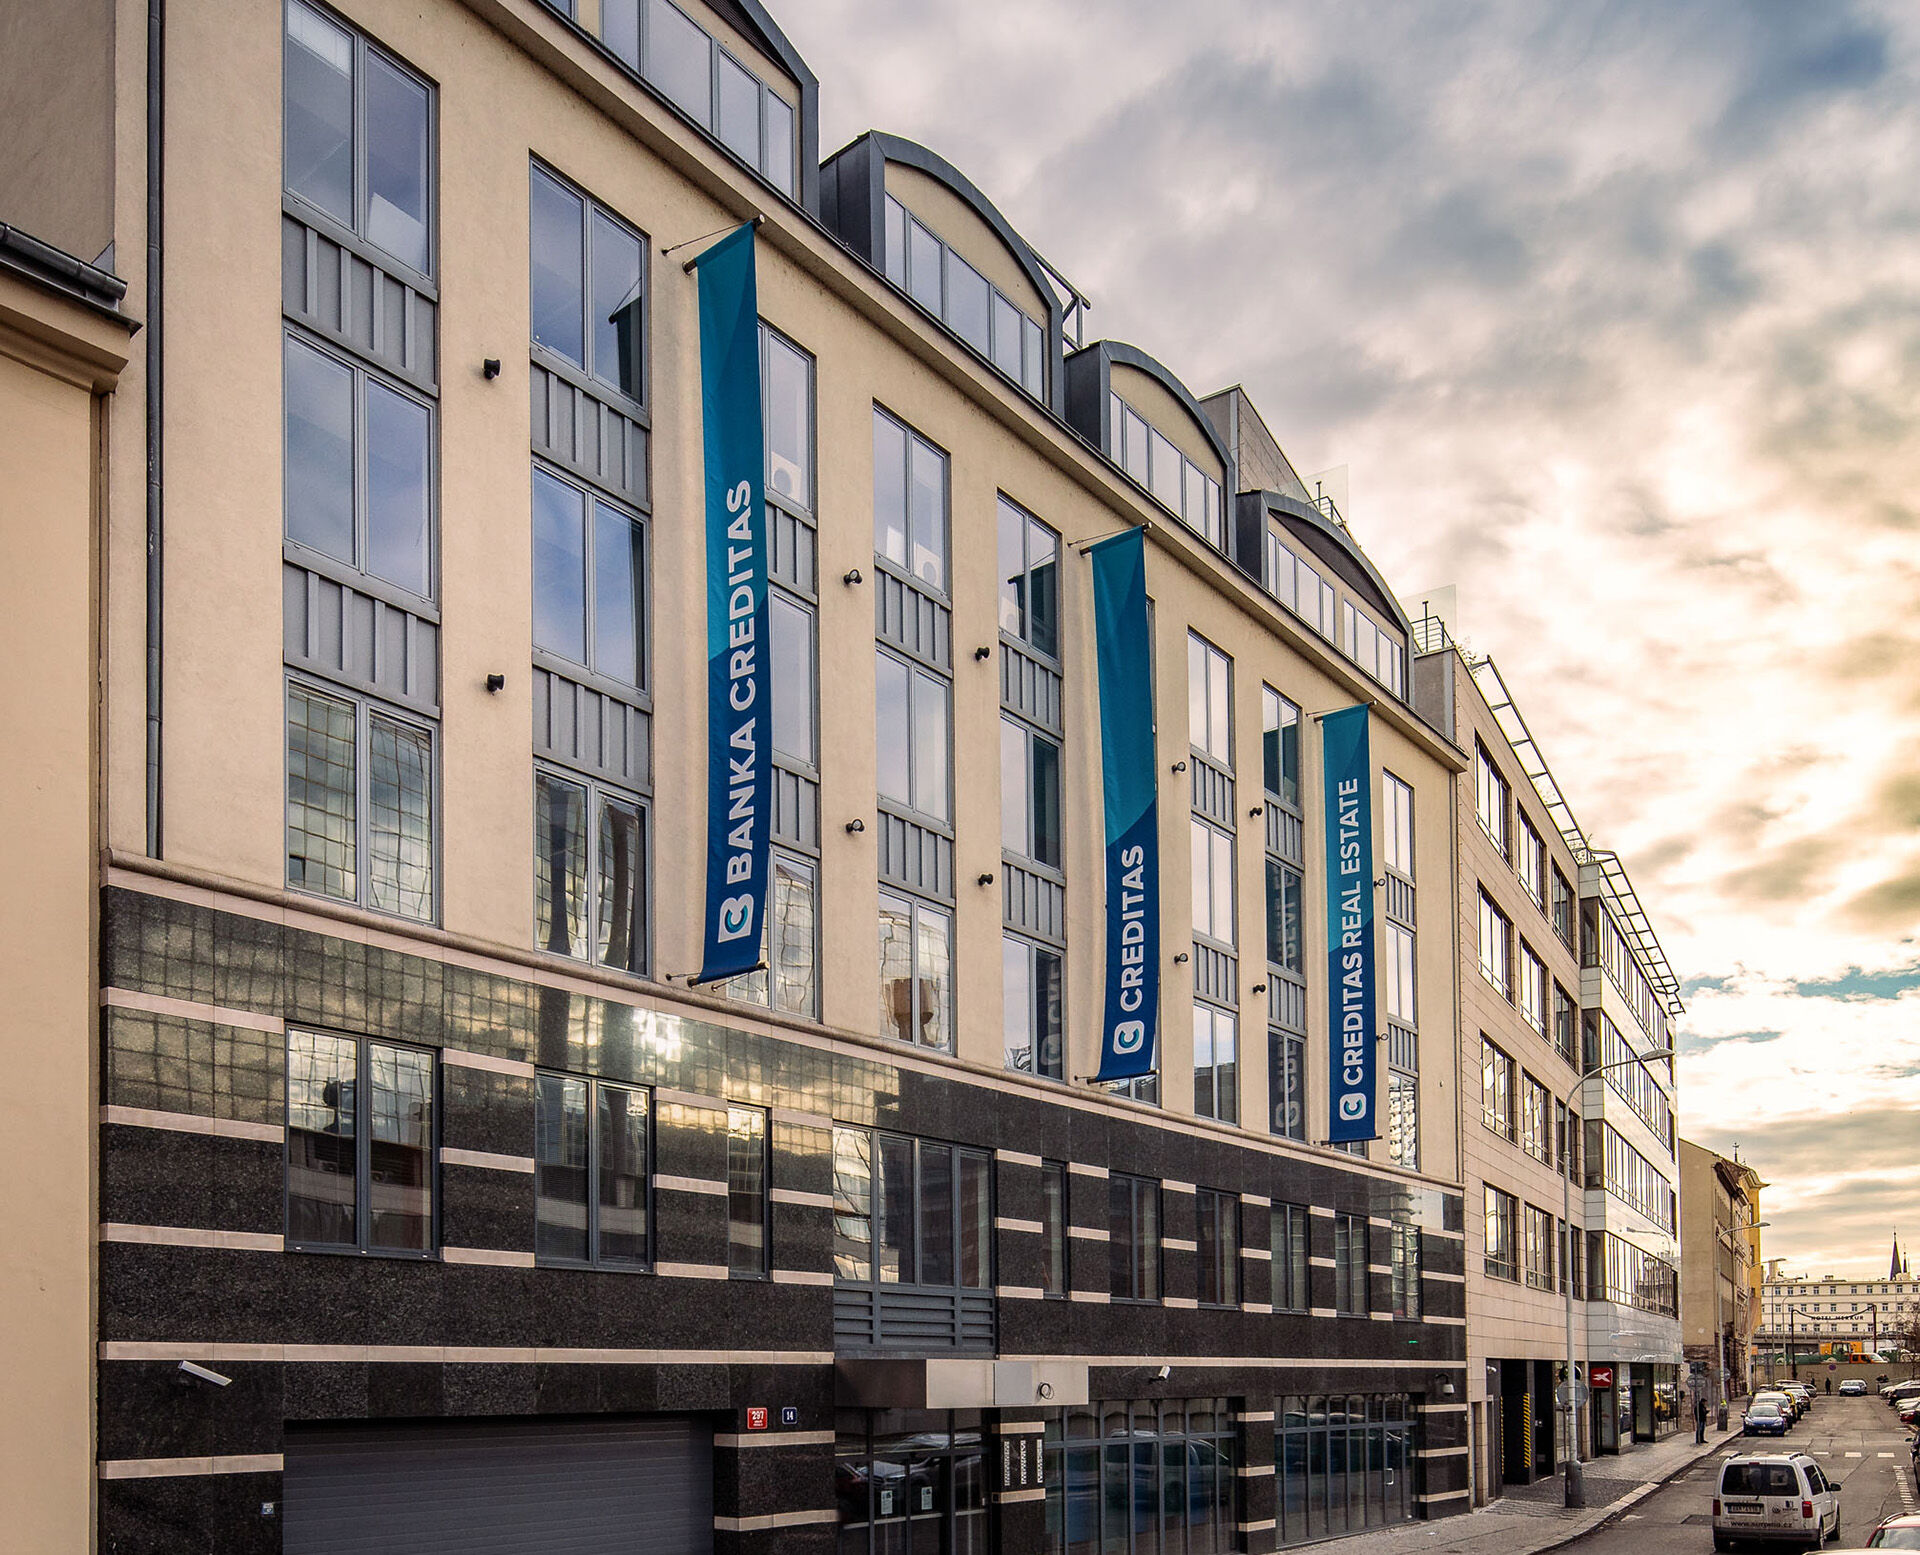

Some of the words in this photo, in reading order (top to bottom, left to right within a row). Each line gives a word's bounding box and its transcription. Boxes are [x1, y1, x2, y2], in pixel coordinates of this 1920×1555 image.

[726, 480, 756, 712] CREDITAS
[727, 718, 756, 884] BANKA
[1338, 778, 1361, 875] ESTATE
[1120, 845, 1144, 1012] CREDITAS
[1341, 880, 1362, 949] REAL
[1343, 952, 1364, 1086] CREDITAS
[751, 1410, 764, 1420] 297
[786, 1411, 794, 1421] 14
